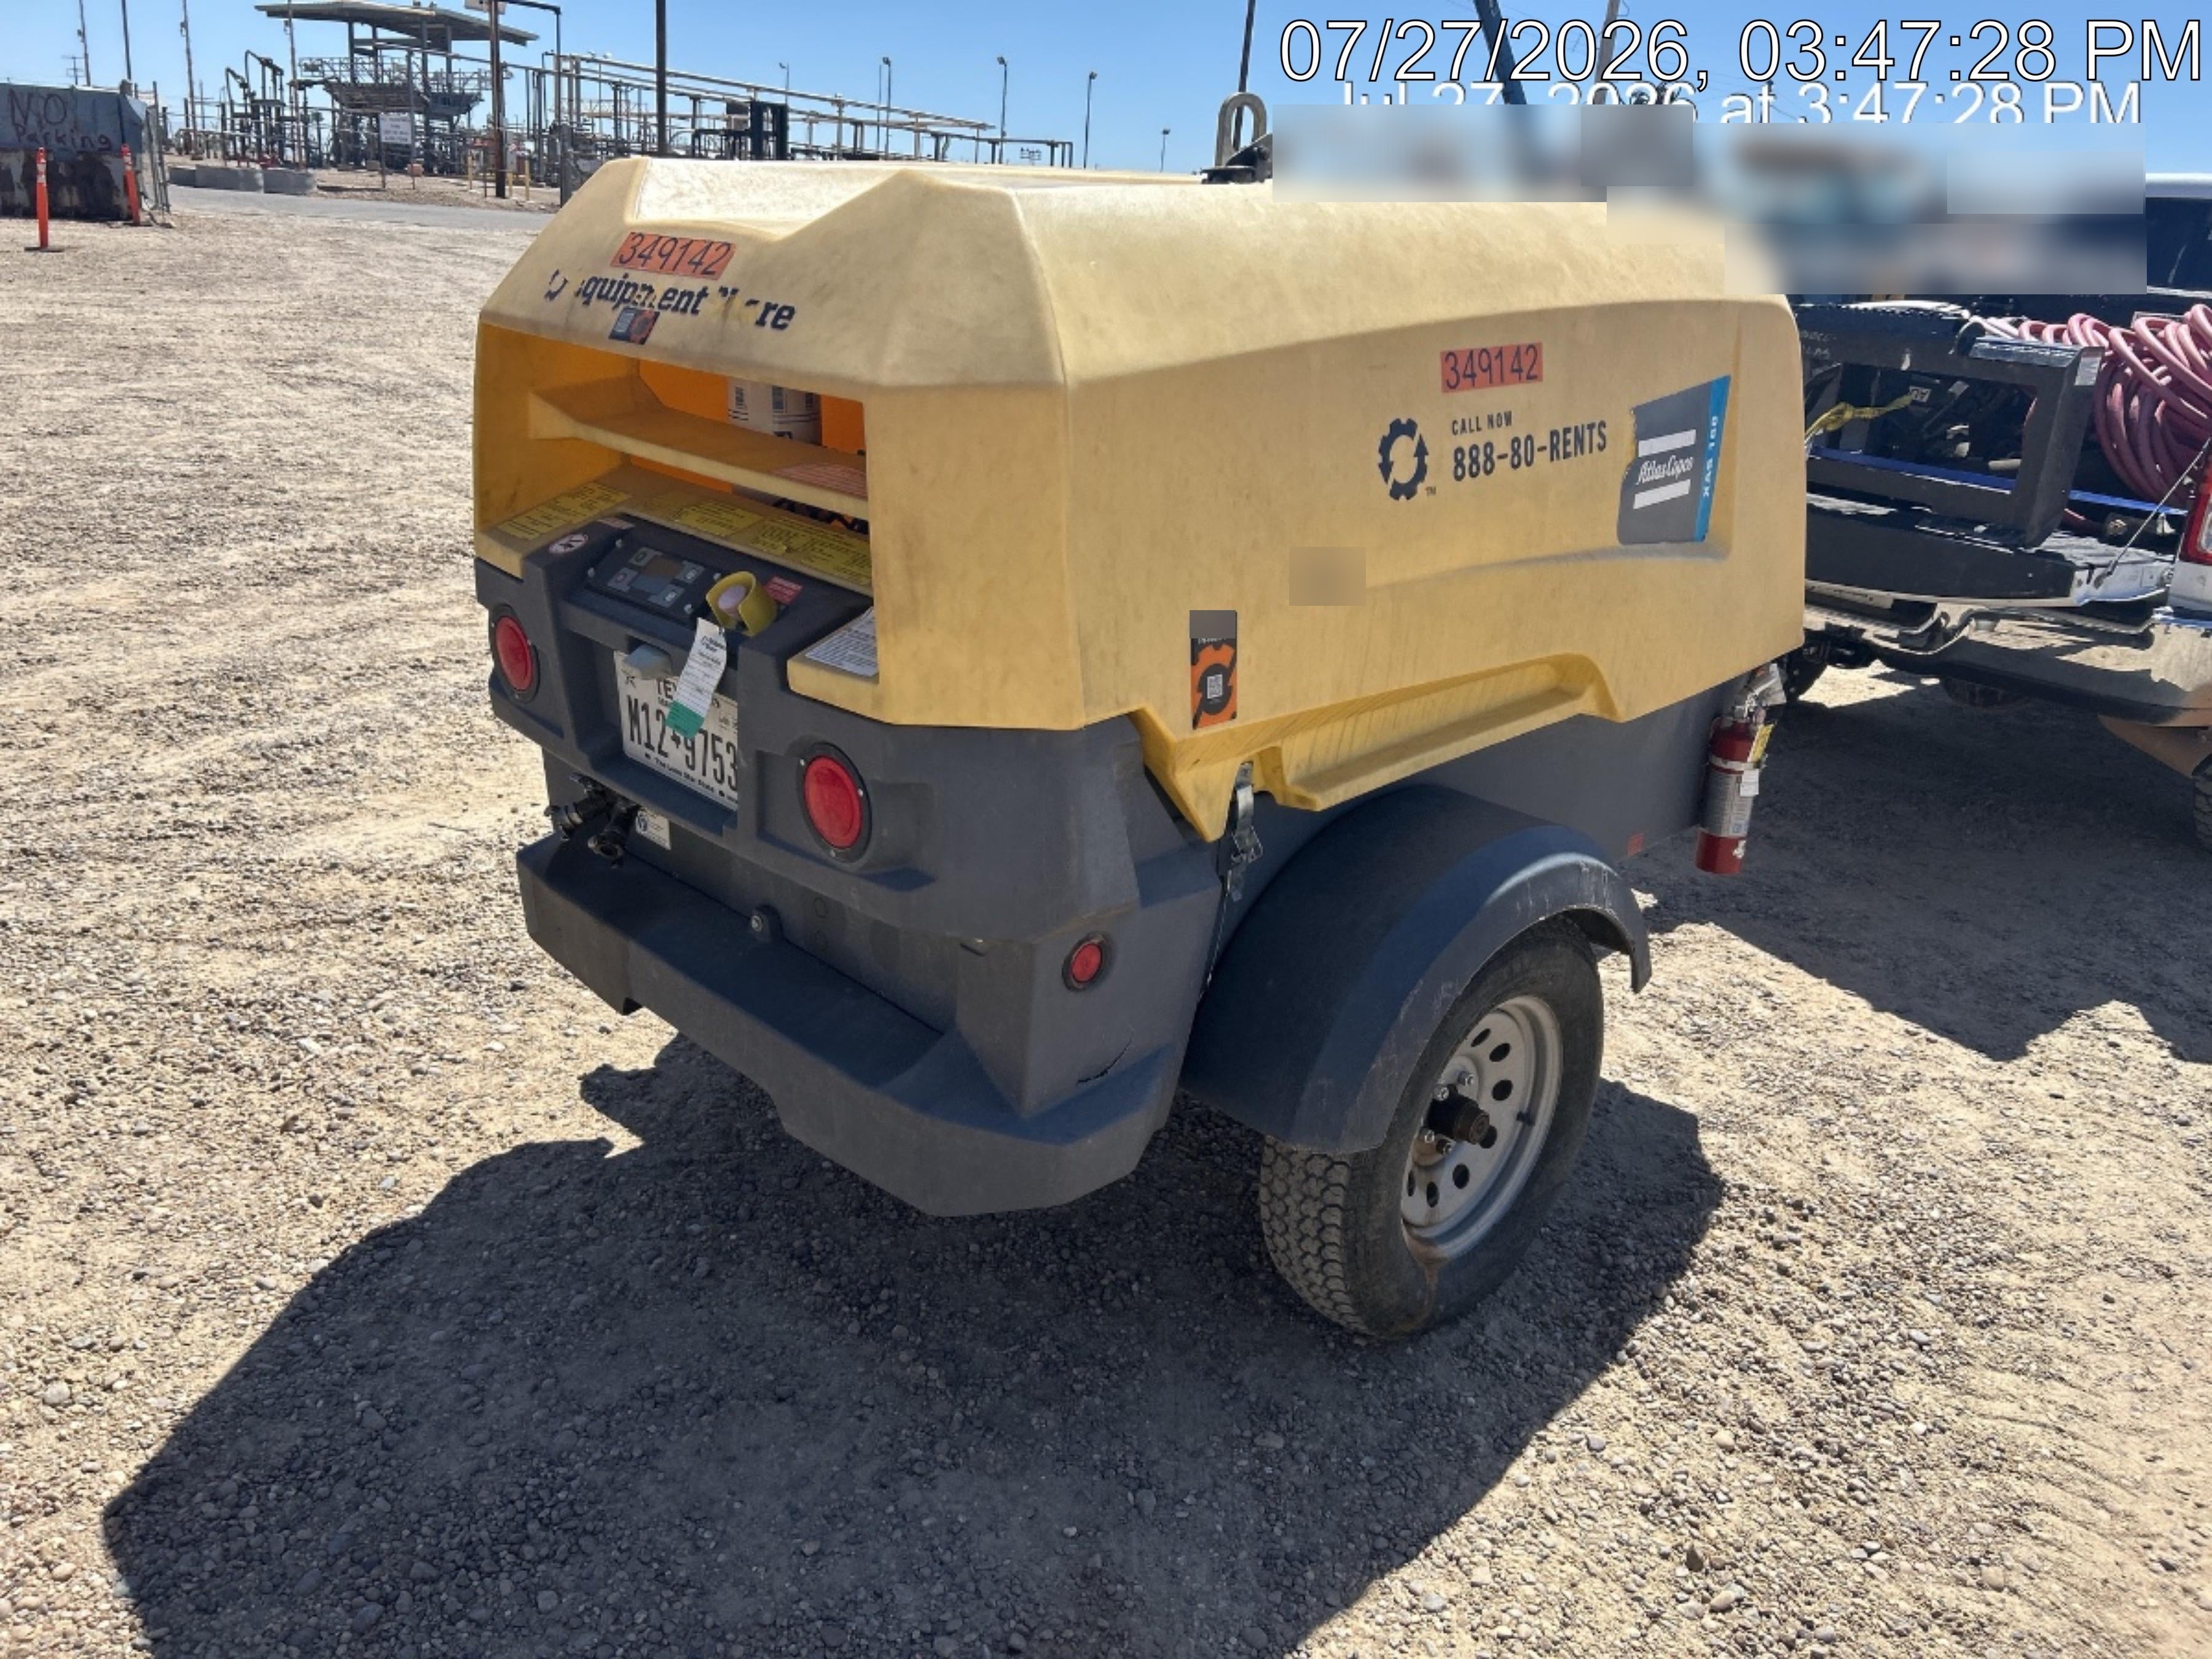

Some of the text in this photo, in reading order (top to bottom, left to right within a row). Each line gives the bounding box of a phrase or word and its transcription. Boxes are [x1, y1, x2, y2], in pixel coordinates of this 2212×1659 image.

[9, 88, 68, 125] NO
[15, 123, 112, 151] Parking
[619, 232, 731, 275] 349142
[1445, 344, 1538, 390] 349142
[1451, 410, 1513, 436] CALL NOW
[1453, 420, 1607, 482] 888-80-RENTS
